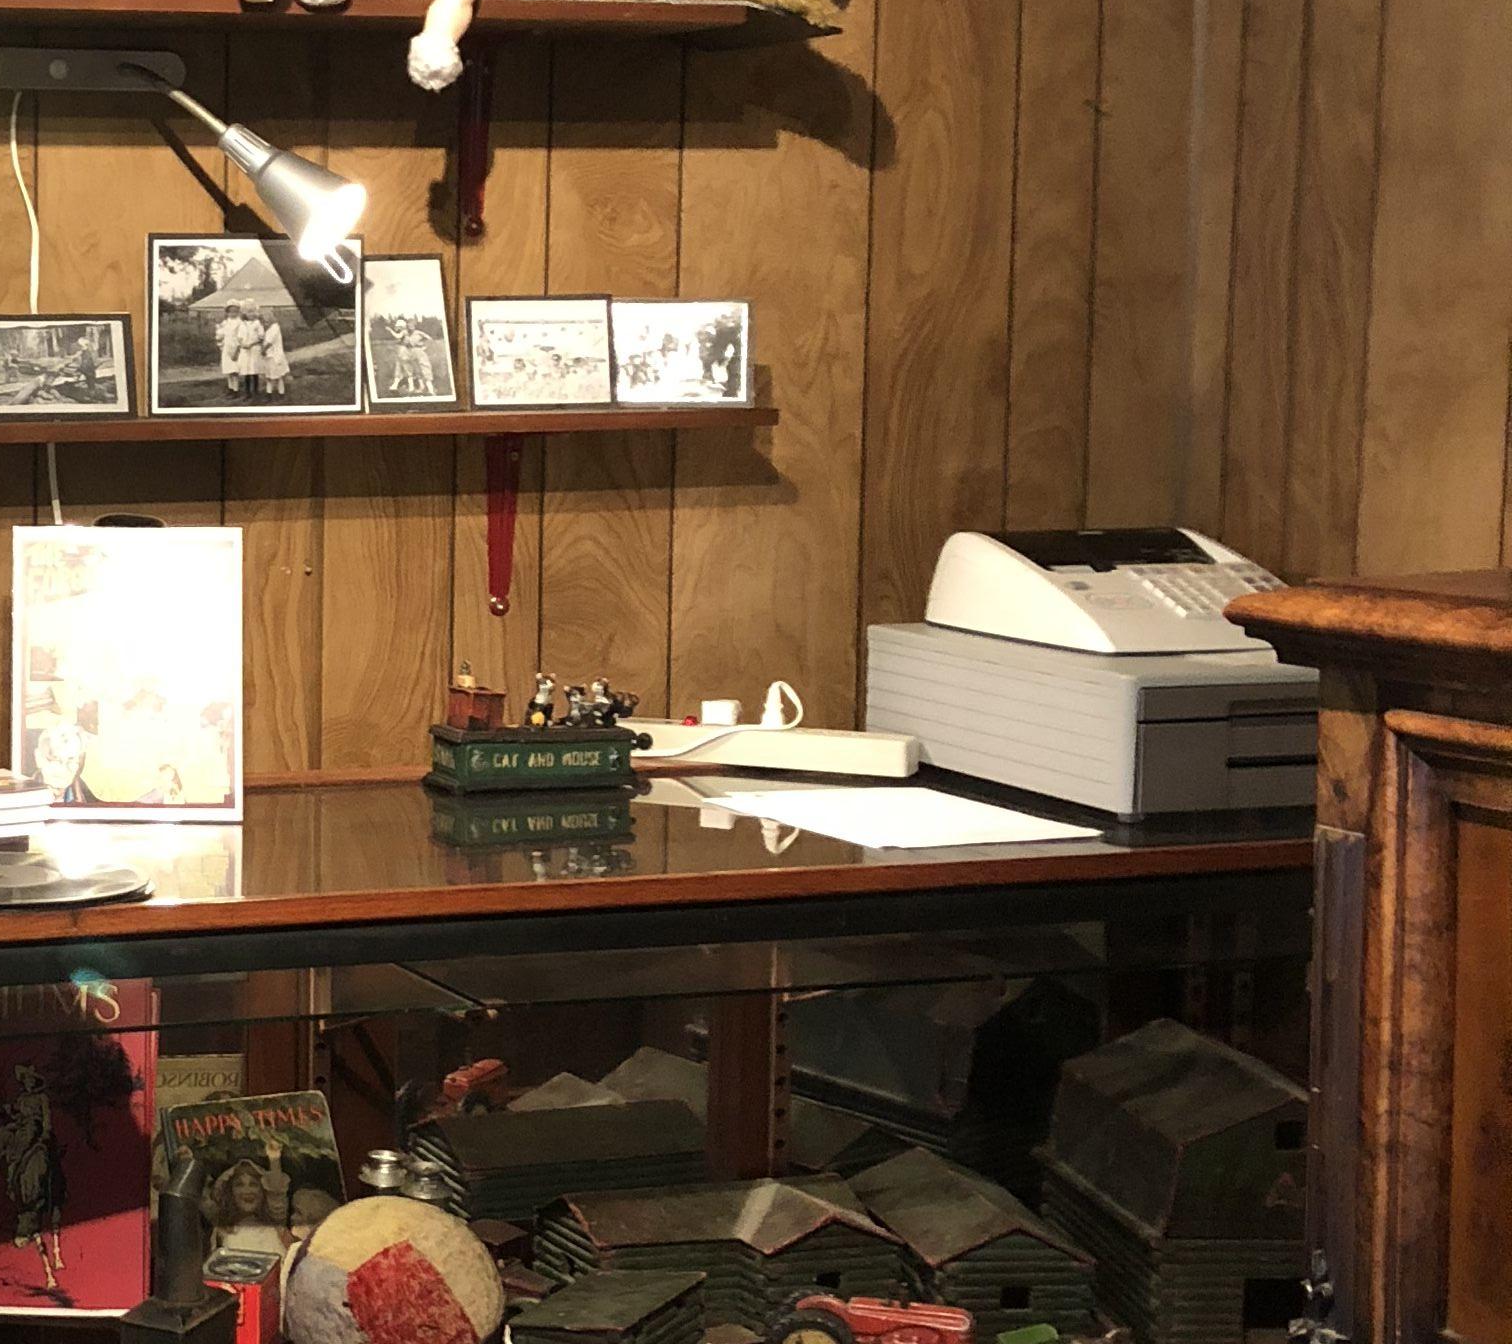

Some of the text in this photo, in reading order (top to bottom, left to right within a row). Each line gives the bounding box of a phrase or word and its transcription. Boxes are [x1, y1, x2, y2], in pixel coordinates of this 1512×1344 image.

[492, 750, 602, 768] CAT AND MOUSE
[174, 1105, 325, 1139] HAPPY TIMES
